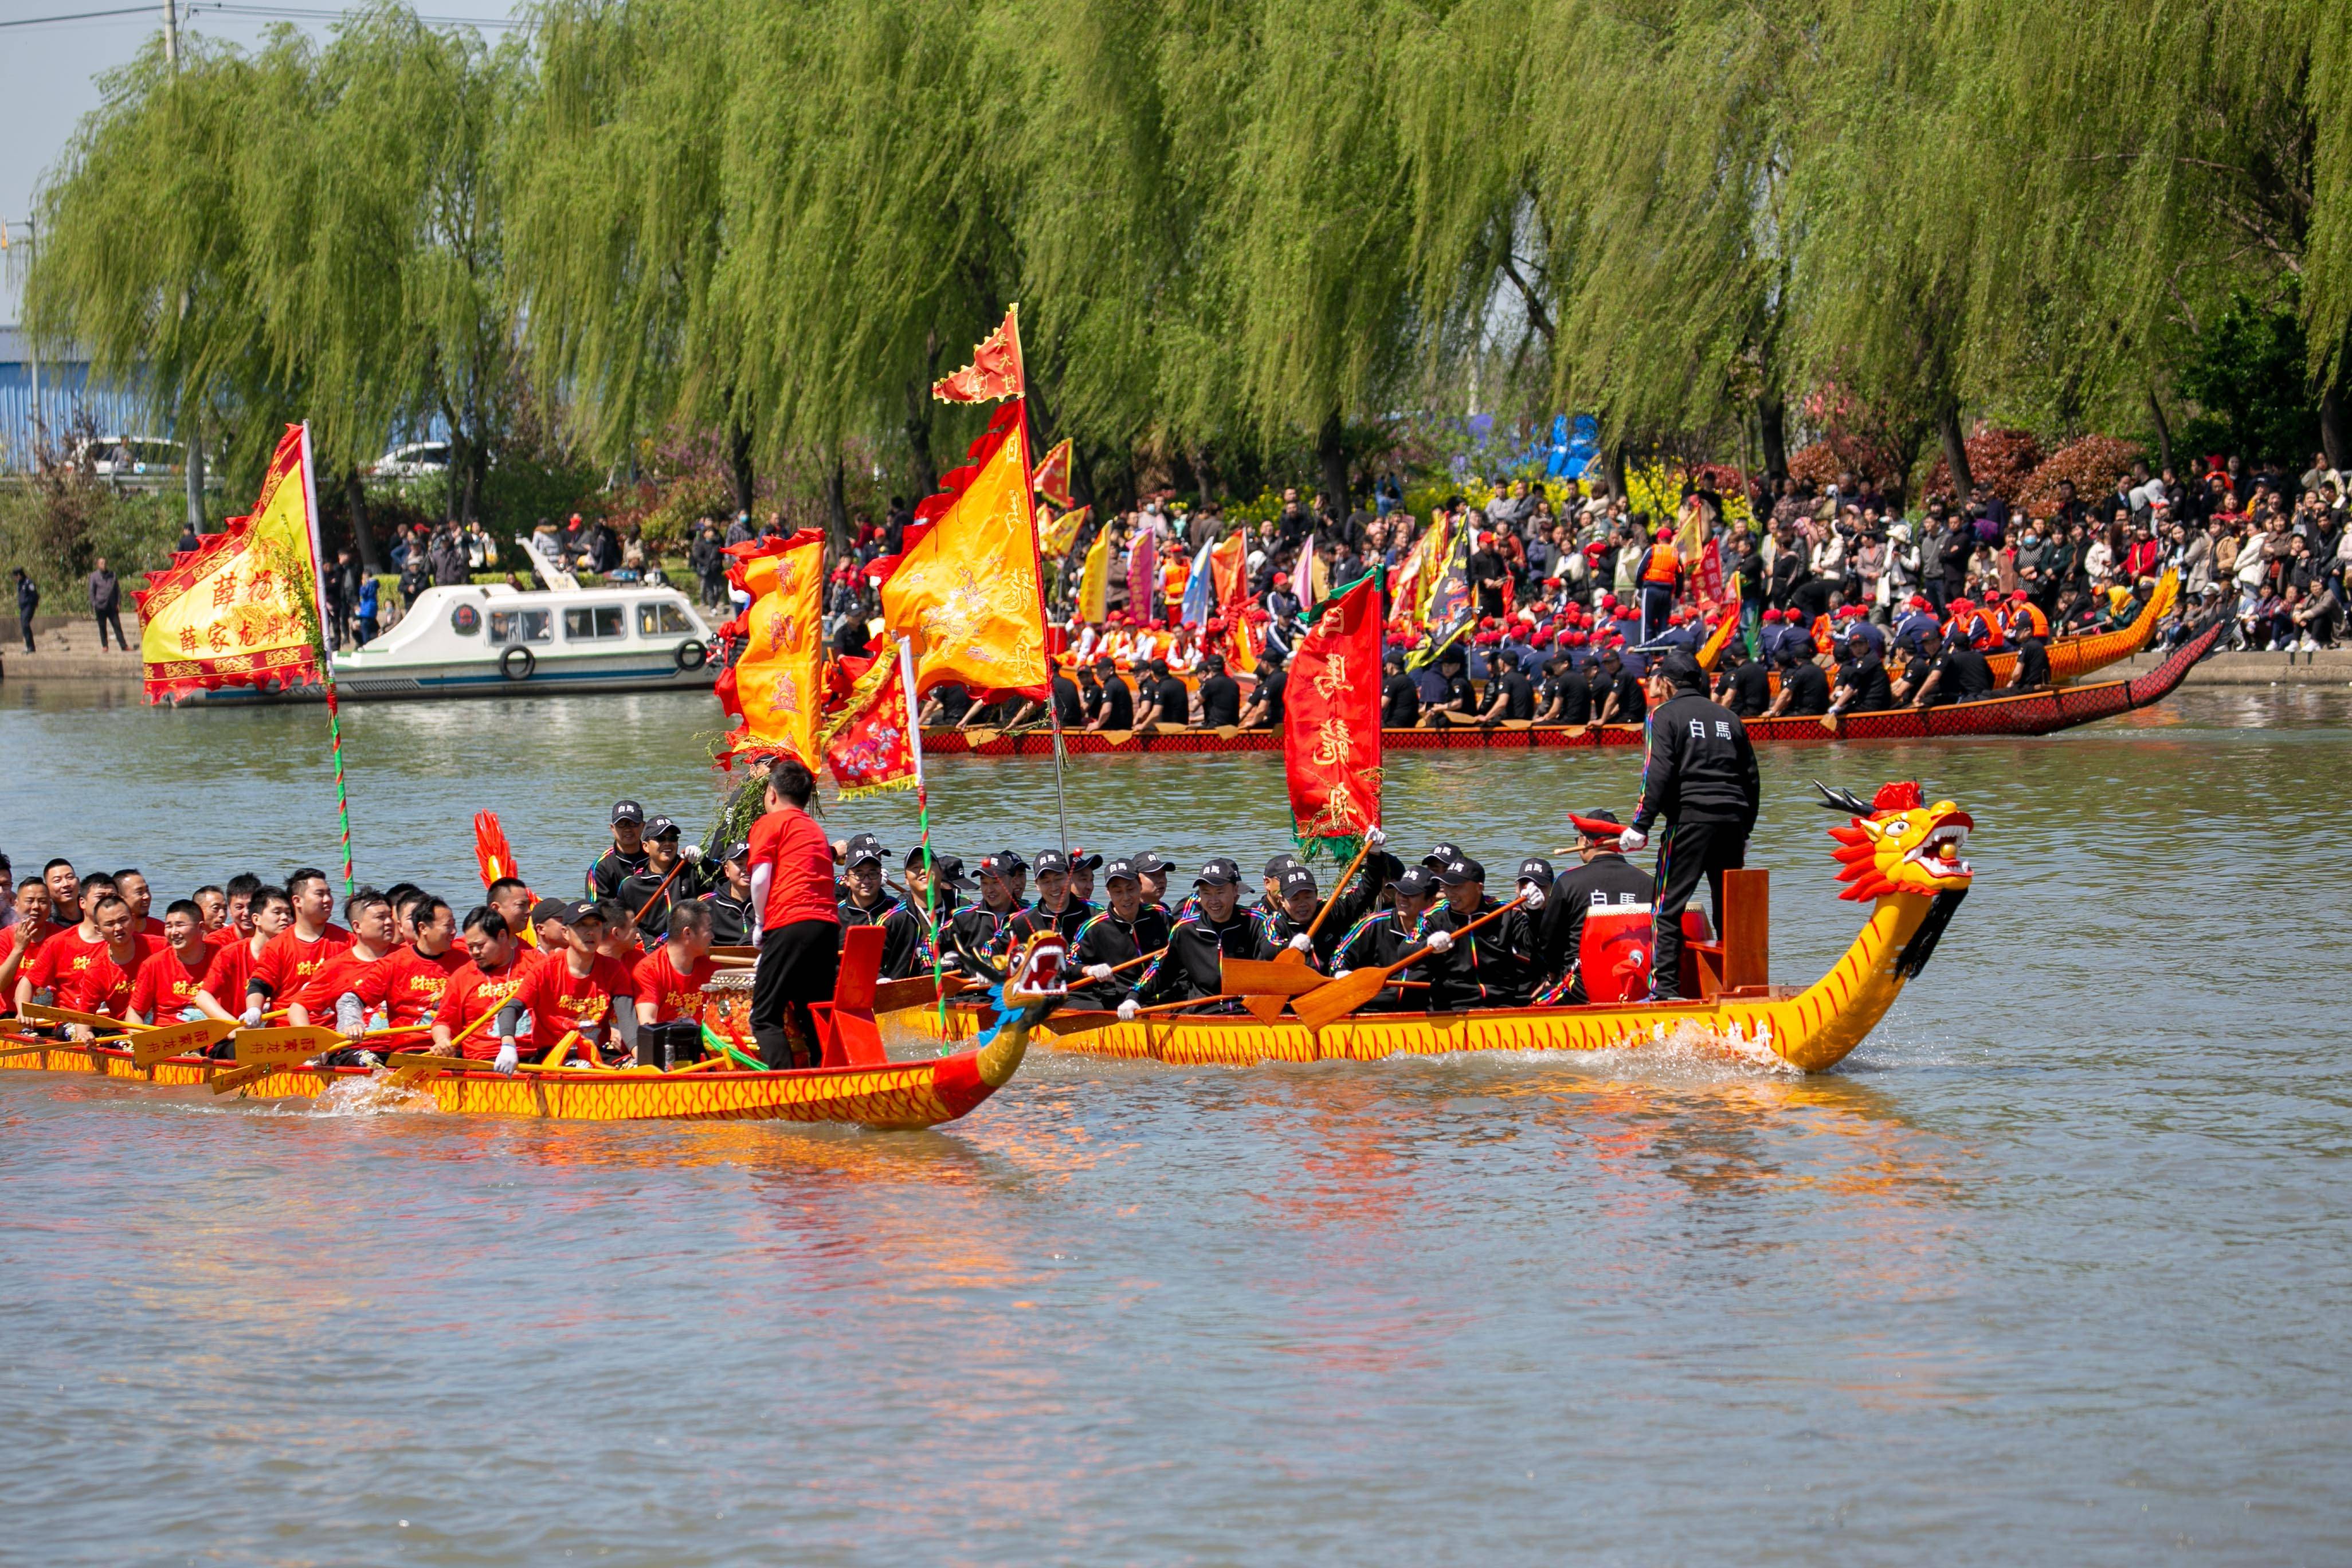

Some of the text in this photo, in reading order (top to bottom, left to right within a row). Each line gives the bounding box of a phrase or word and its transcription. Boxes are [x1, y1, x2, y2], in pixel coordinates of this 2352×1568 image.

[1689, 718, 1731, 740] 白馬
[1040, 854, 1056, 865] 白馬
[1110, 863, 1127, 873] 白馬
[146, 1029, 209, 1054] 薛家龙舟
[250, 1038, 315, 1055] 薛家龙舟
